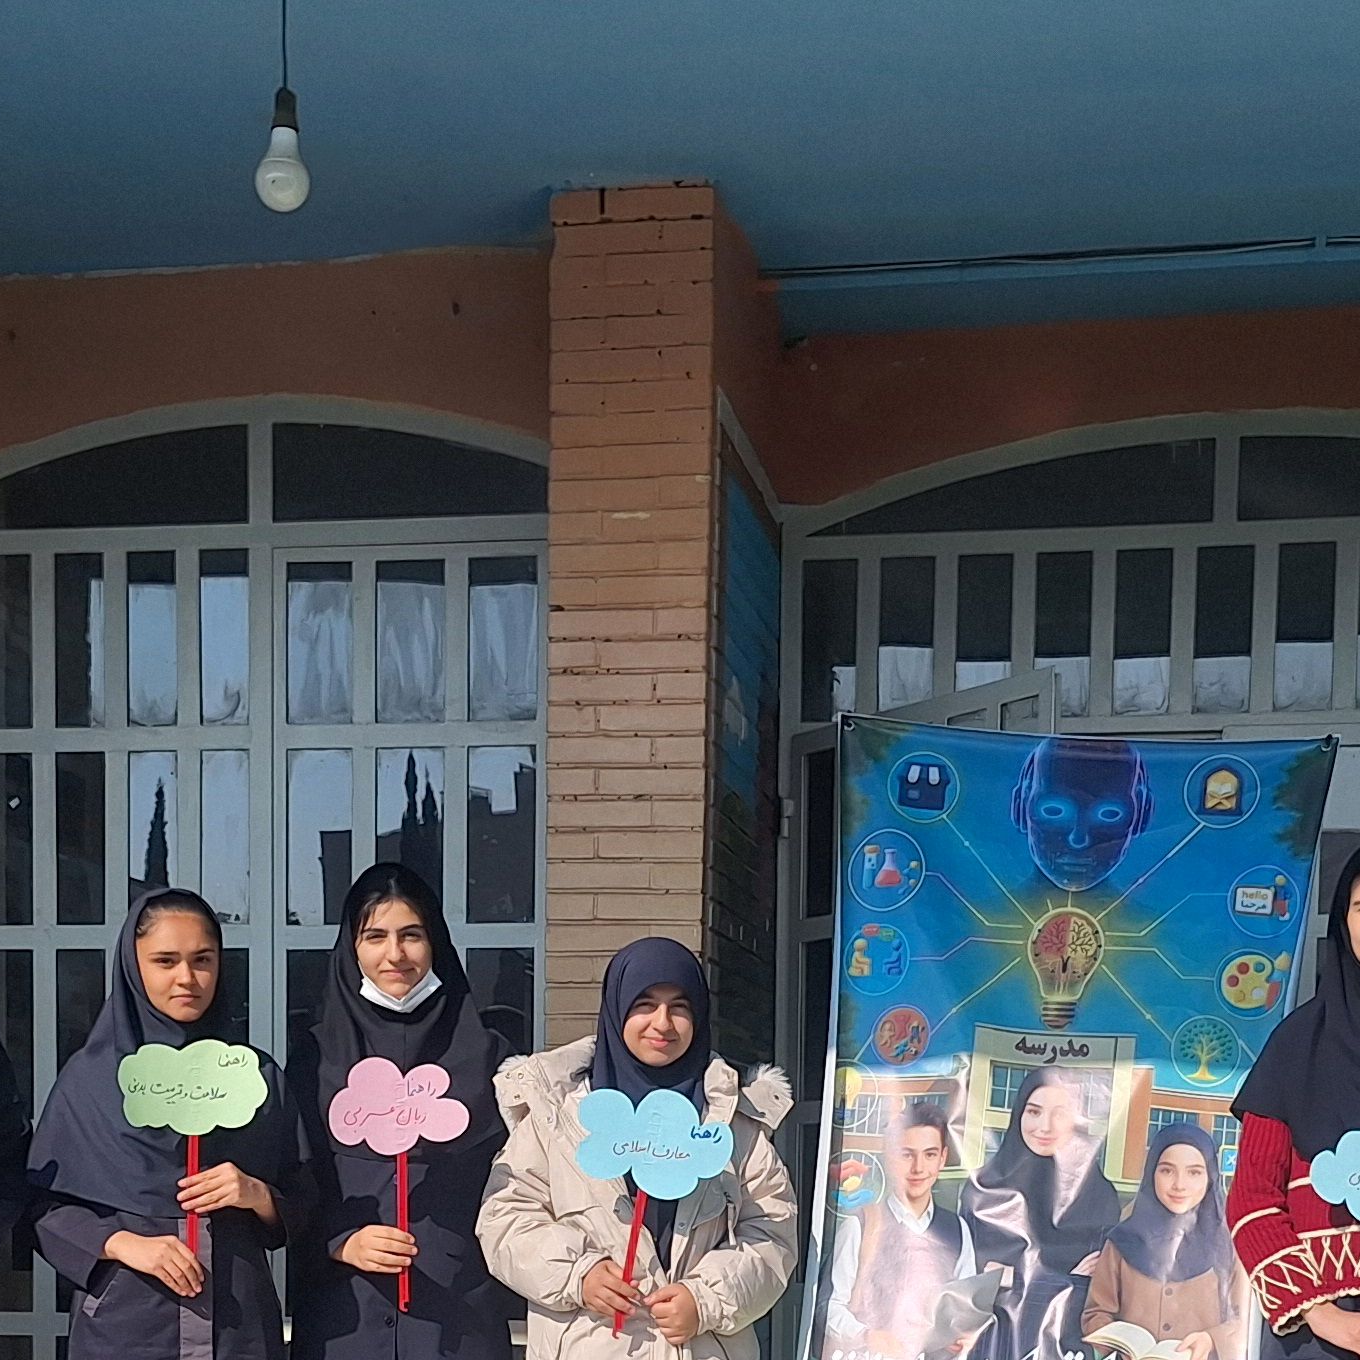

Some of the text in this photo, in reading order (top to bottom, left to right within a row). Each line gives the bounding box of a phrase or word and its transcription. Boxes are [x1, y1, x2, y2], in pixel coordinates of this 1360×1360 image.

[1014, 1036, 1090, 1065] مدرسه
[127, 1077, 146, 1096] بدنی
[189, 1085, 228, 1101] سلامت
[343, 1105, 397, 1134] عربی
[612, 1139, 691, 1160] معارف اسلامی
